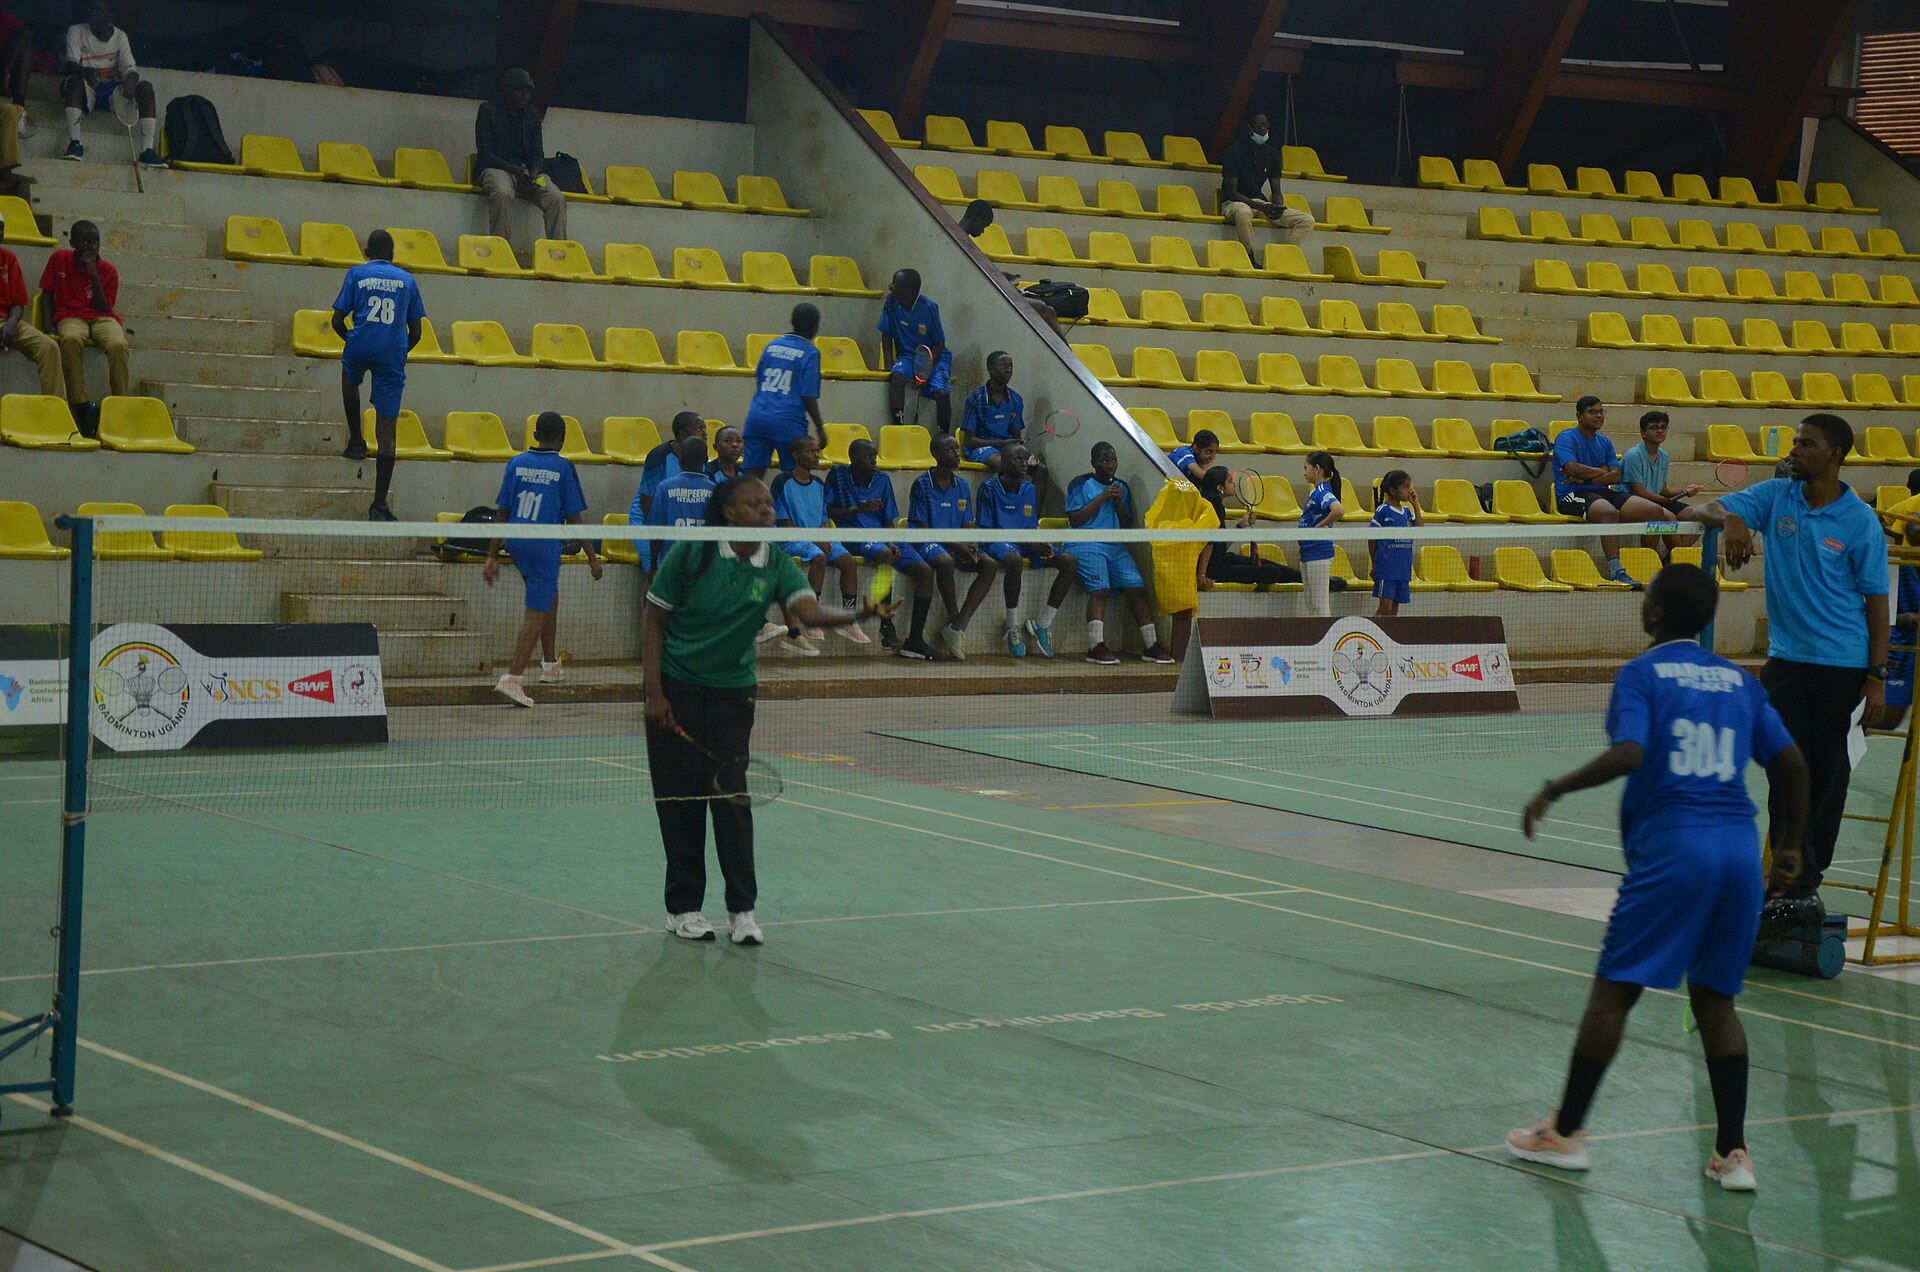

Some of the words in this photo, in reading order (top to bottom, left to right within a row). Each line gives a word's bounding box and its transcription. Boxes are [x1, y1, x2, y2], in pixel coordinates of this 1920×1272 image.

[367, 296, 395, 324] 28
[761, 368, 793, 395] 324
[517, 490, 543, 521] 101
[1414, 661, 1448, 679] NCS
[1456, 663, 1479, 672] BWF
[228, 679, 281, 702] NCS
[293, 681, 329, 692] BWF
[1336, 680, 1374, 708] BADMINTON
[1374, 679, 1392, 706] UGANDA
[98, 703, 156, 739] BADMINTON
[158, 701, 188, 736] UGANDA
[1669, 718, 1737, 782] 304
[1175, 994, 1345, 1012] Uganda
[914, 1007, 1167, 1034] Badminton
[594, 1028, 894, 1063] Association
